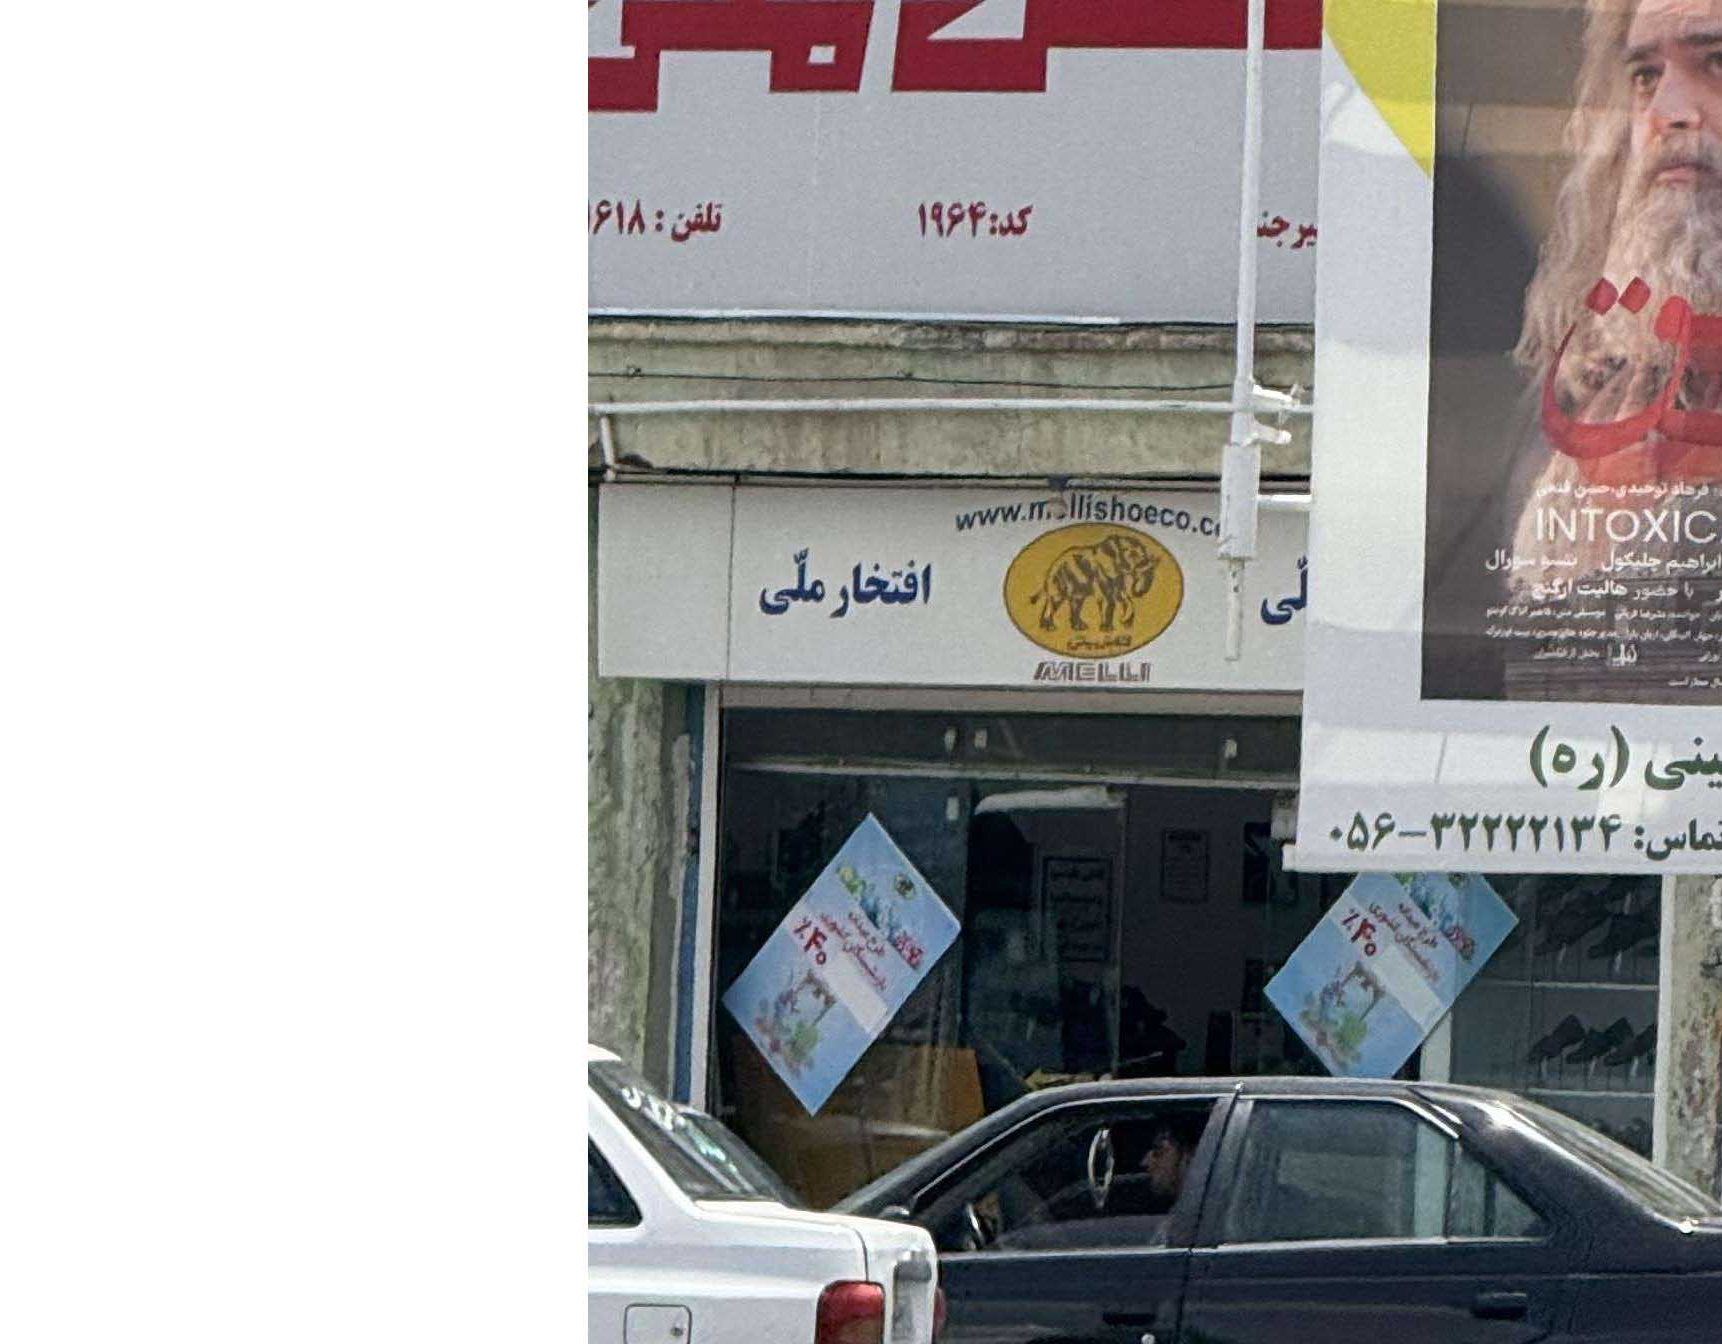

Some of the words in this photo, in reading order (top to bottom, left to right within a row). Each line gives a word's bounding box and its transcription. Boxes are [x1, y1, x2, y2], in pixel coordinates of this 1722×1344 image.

[955, 493, 1221, 537] www.mllishoeco.c
[830, 560, 933, 619] افتخار
[1260, 555, 1308, 625] لّی
[1665, 552, 1722, 573] ابراهیم
[1529, 725, 1631, 793] (ره)
